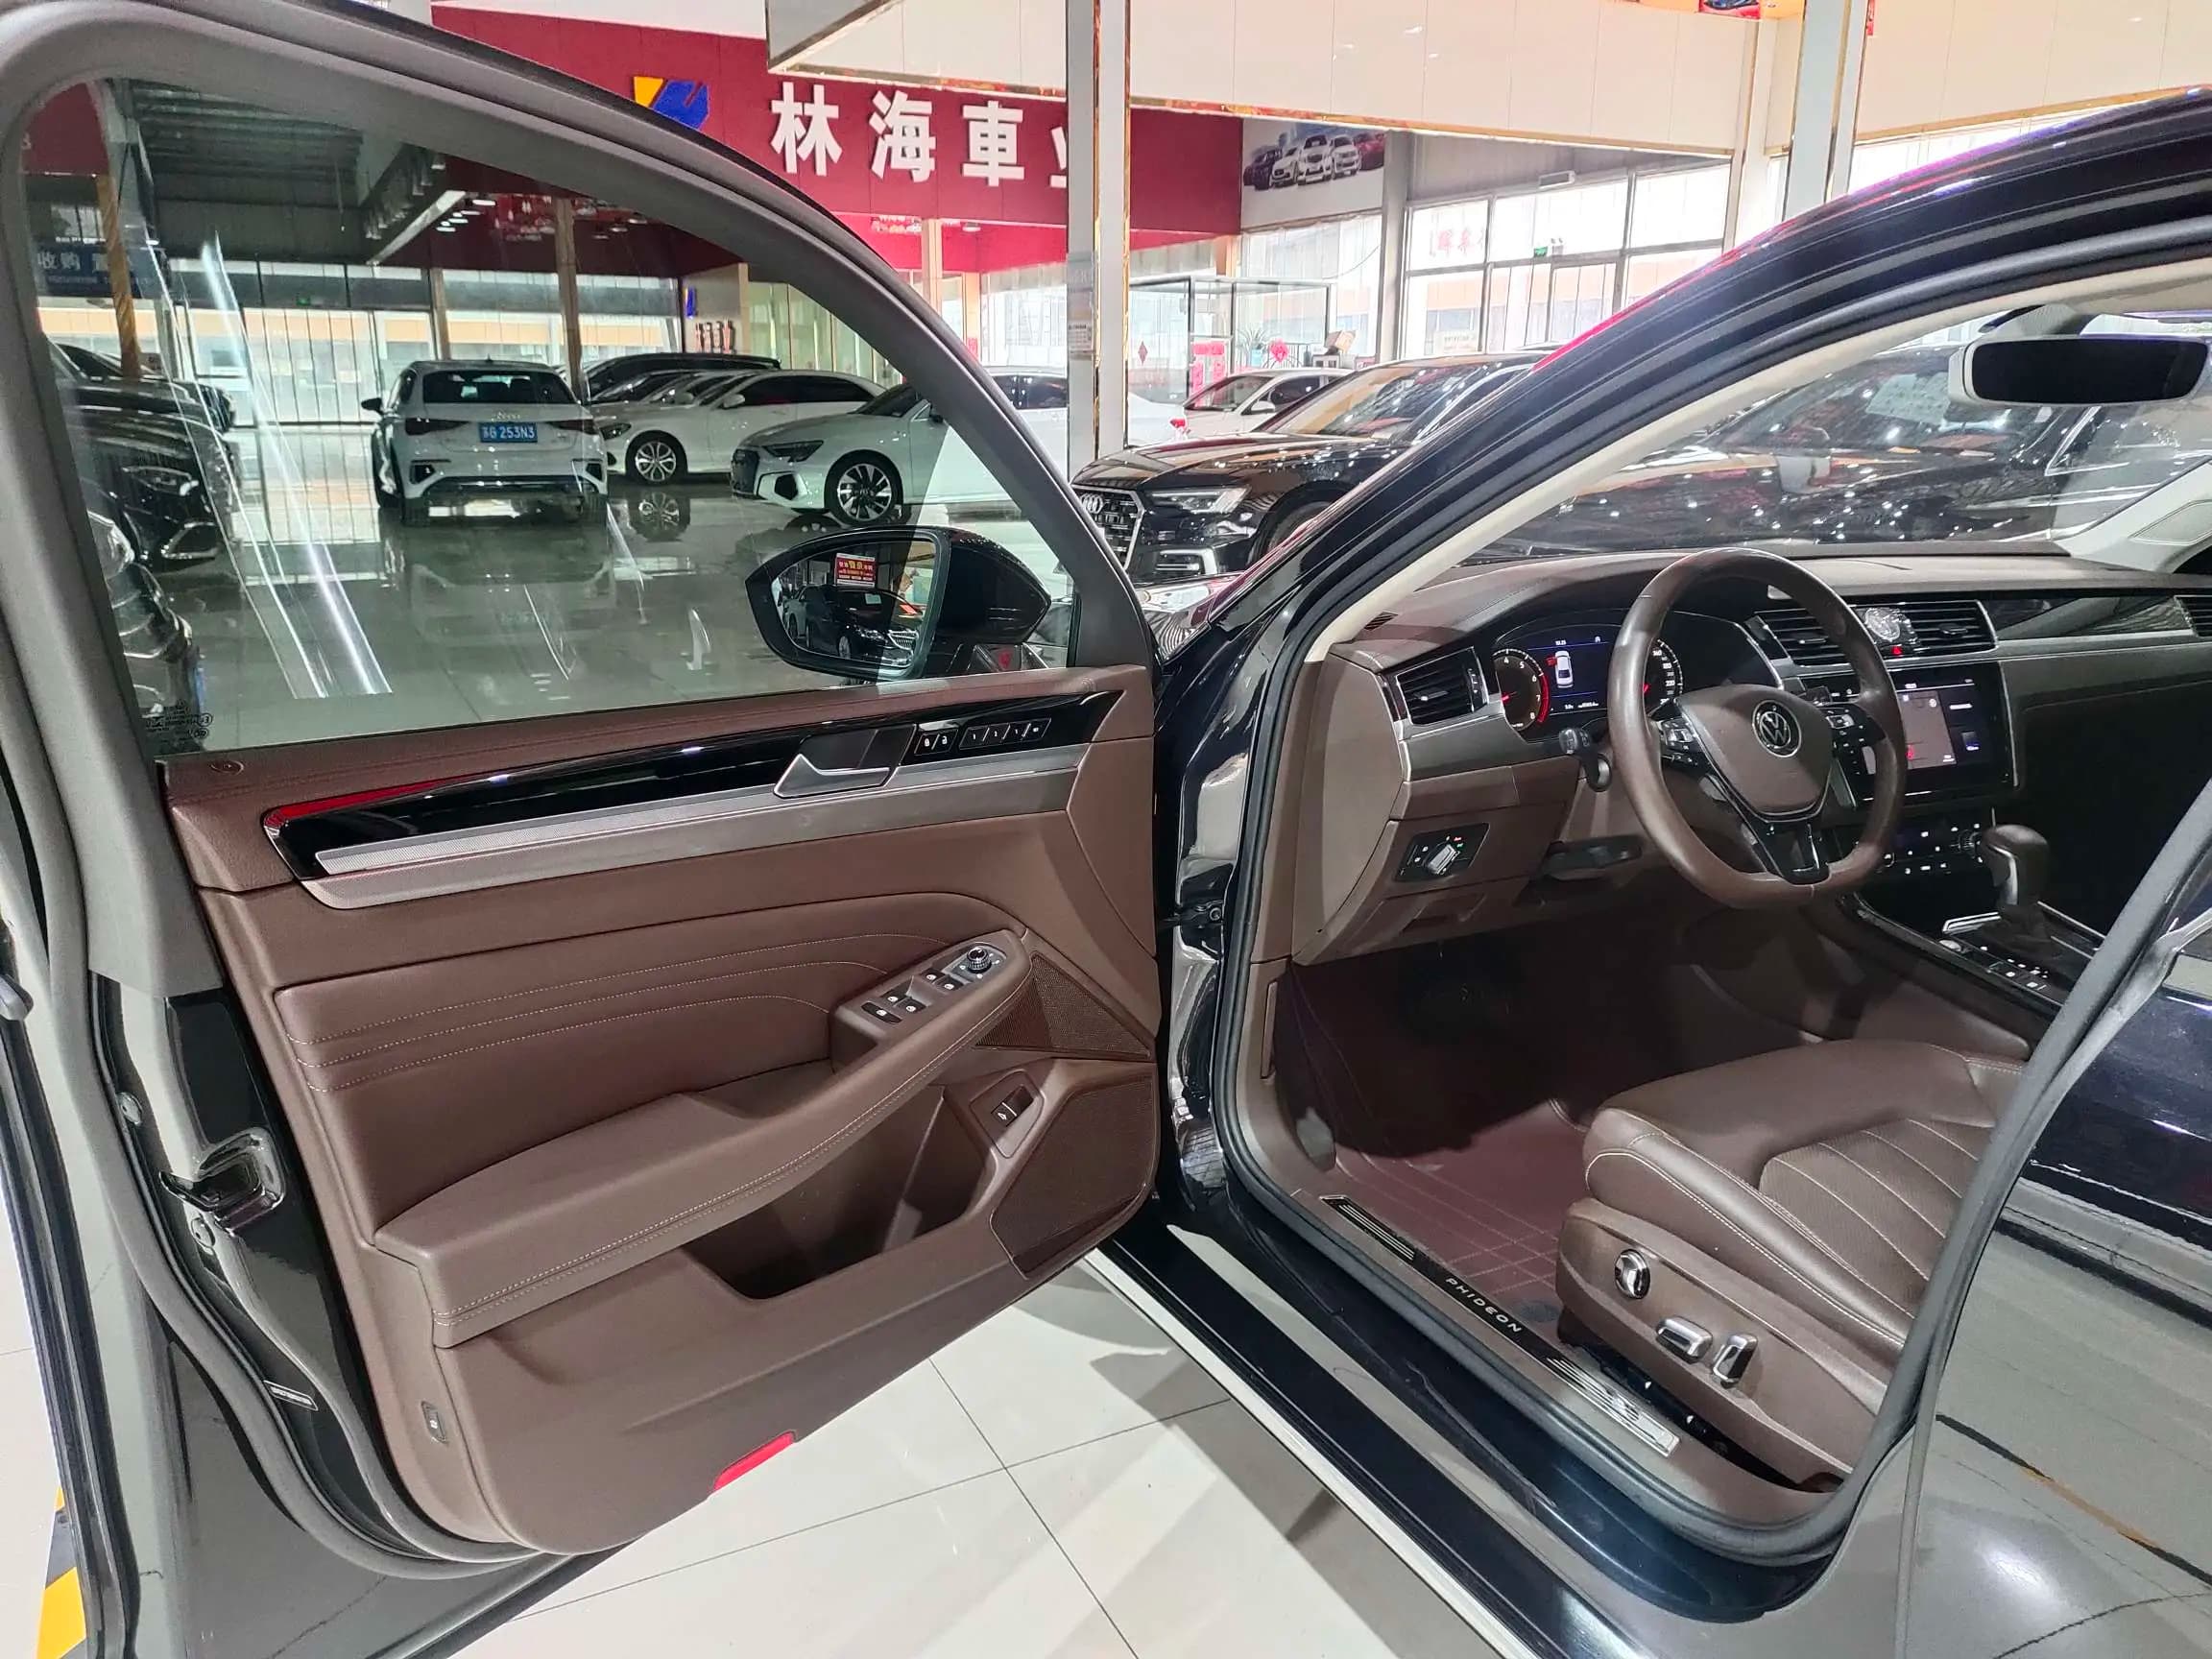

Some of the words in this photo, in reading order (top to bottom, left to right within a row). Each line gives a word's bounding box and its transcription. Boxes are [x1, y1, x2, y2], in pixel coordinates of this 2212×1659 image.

[770, 81, 1067, 187] 林海車
[1446, 1278, 1523, 1333] PHIDEON
